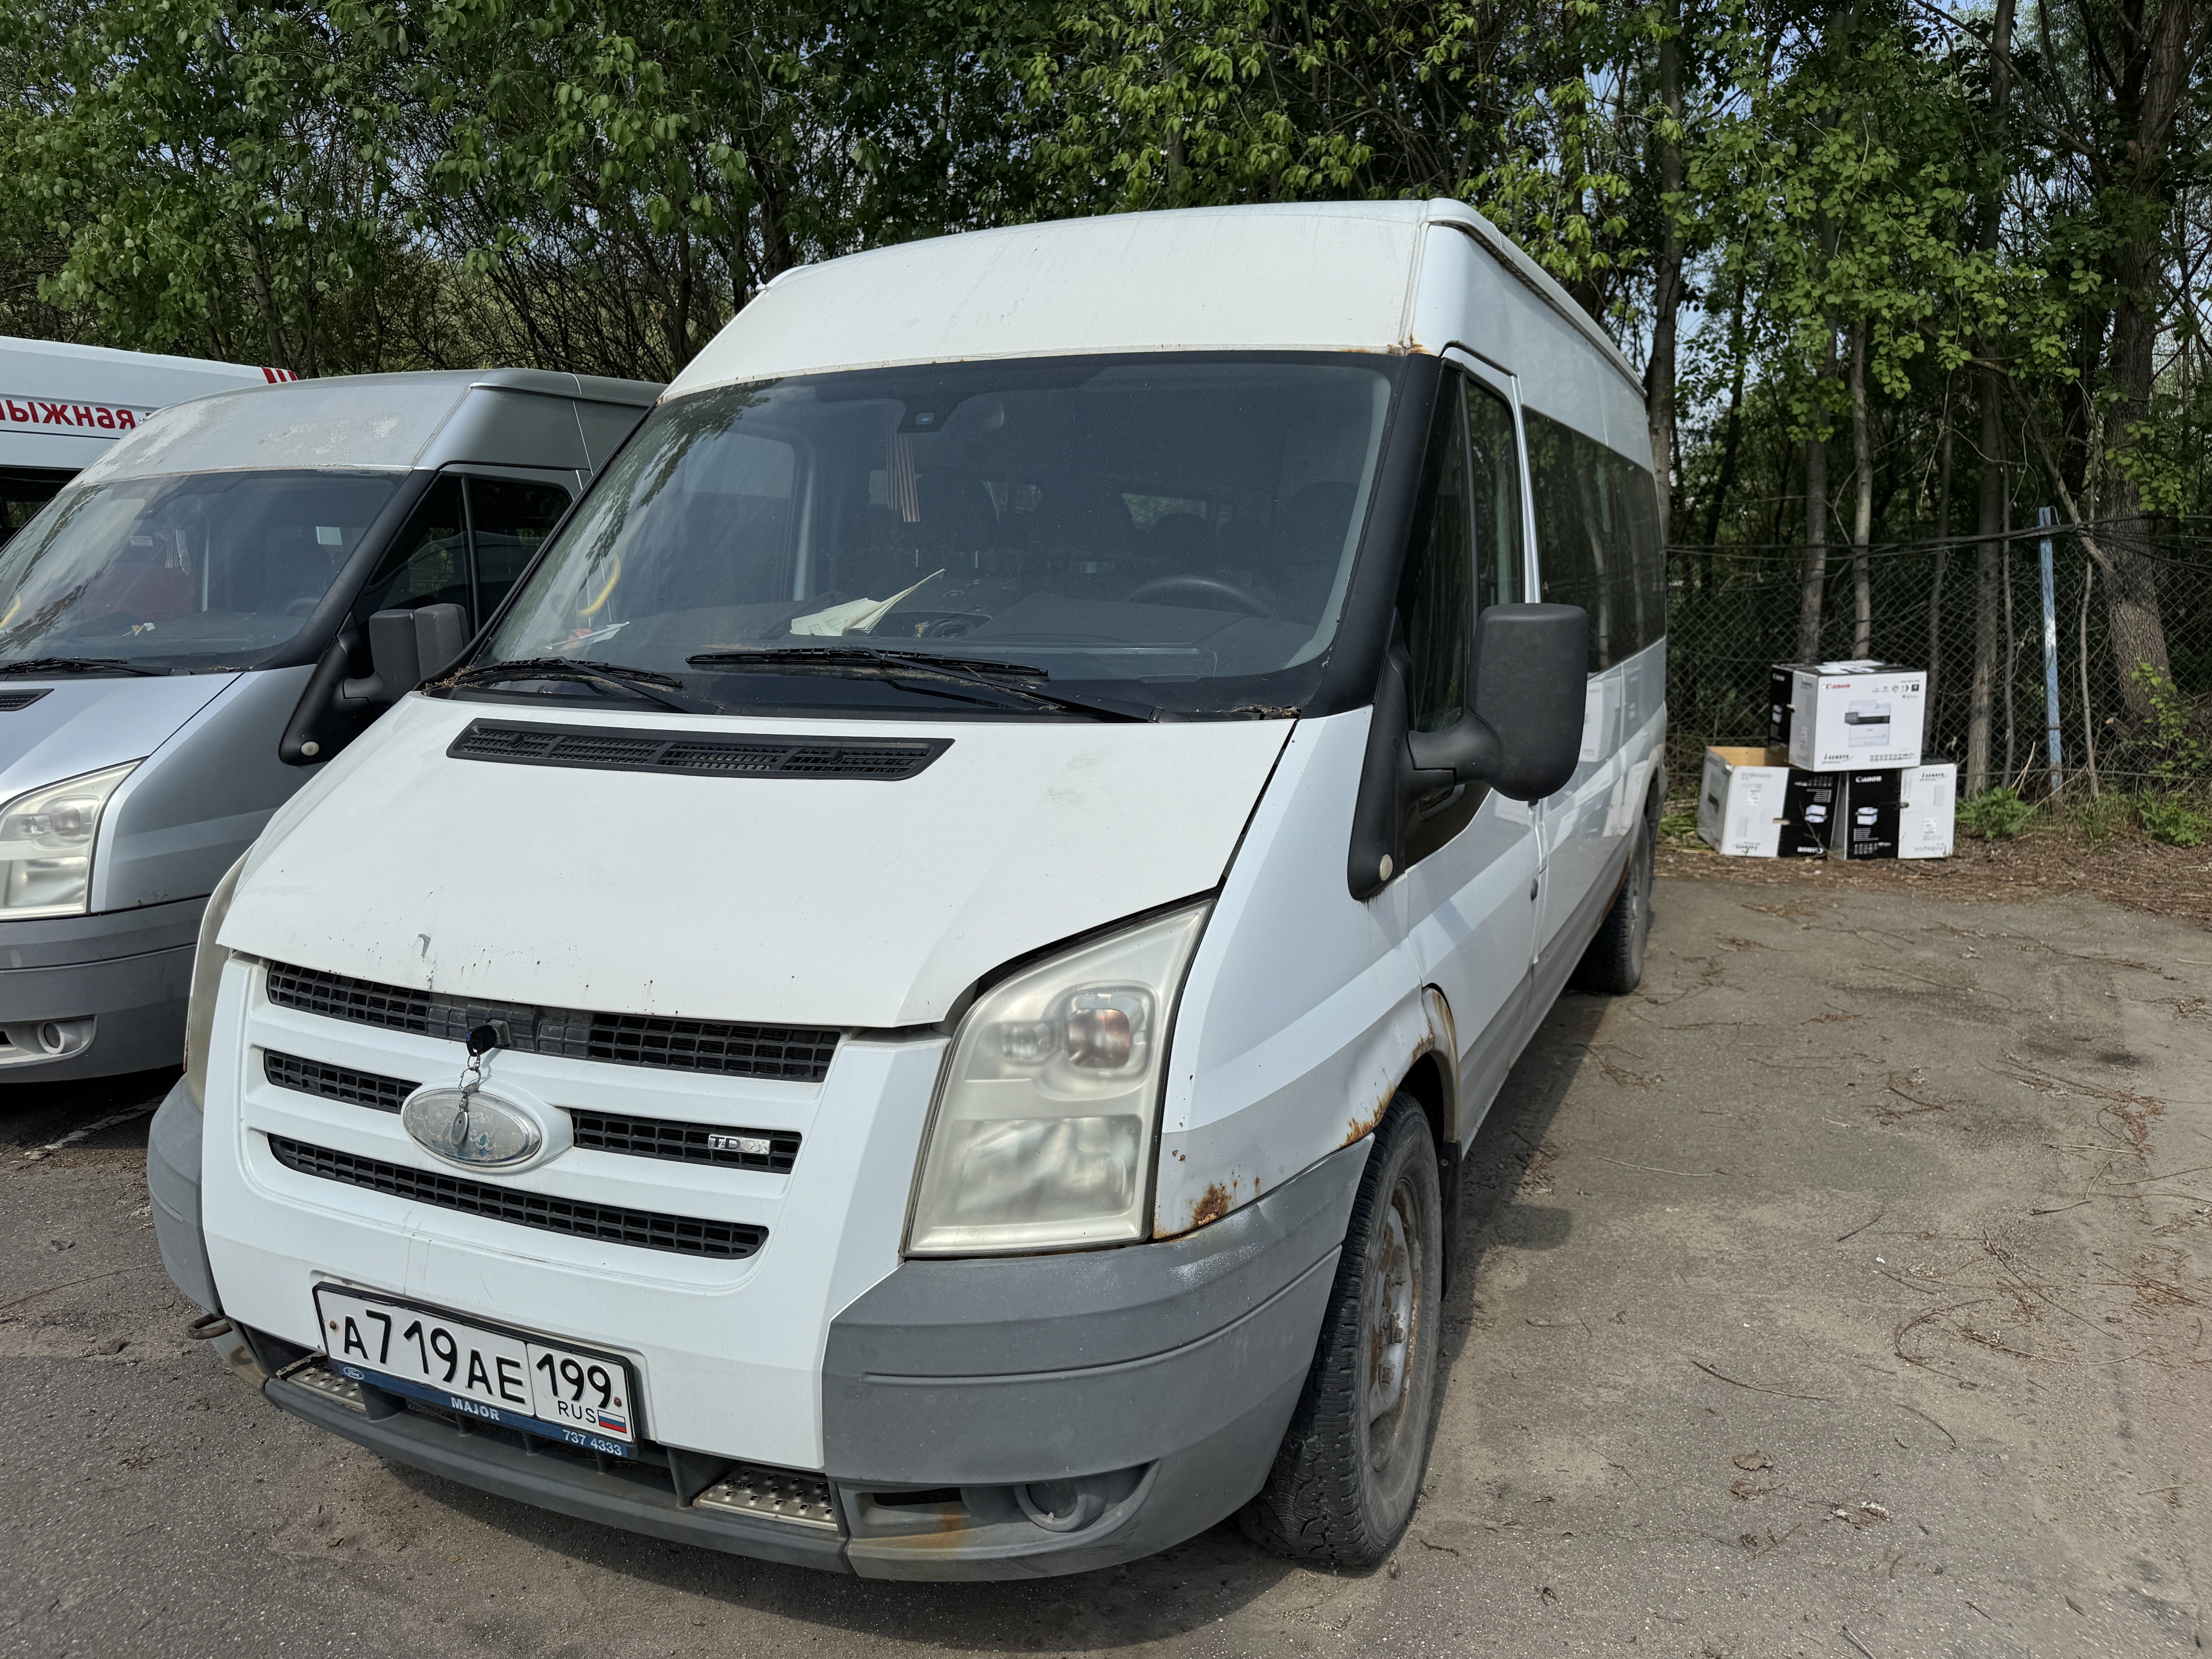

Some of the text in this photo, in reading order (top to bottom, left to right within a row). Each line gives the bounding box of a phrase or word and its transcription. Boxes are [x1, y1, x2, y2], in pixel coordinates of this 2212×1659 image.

[536, 1353, 612, 1410] 199
[451, 1397, 500, 1421] MAJOR
[558, 1400, 596, 1424] RUS
[563, 1429, 622, 1456] 737 4333
